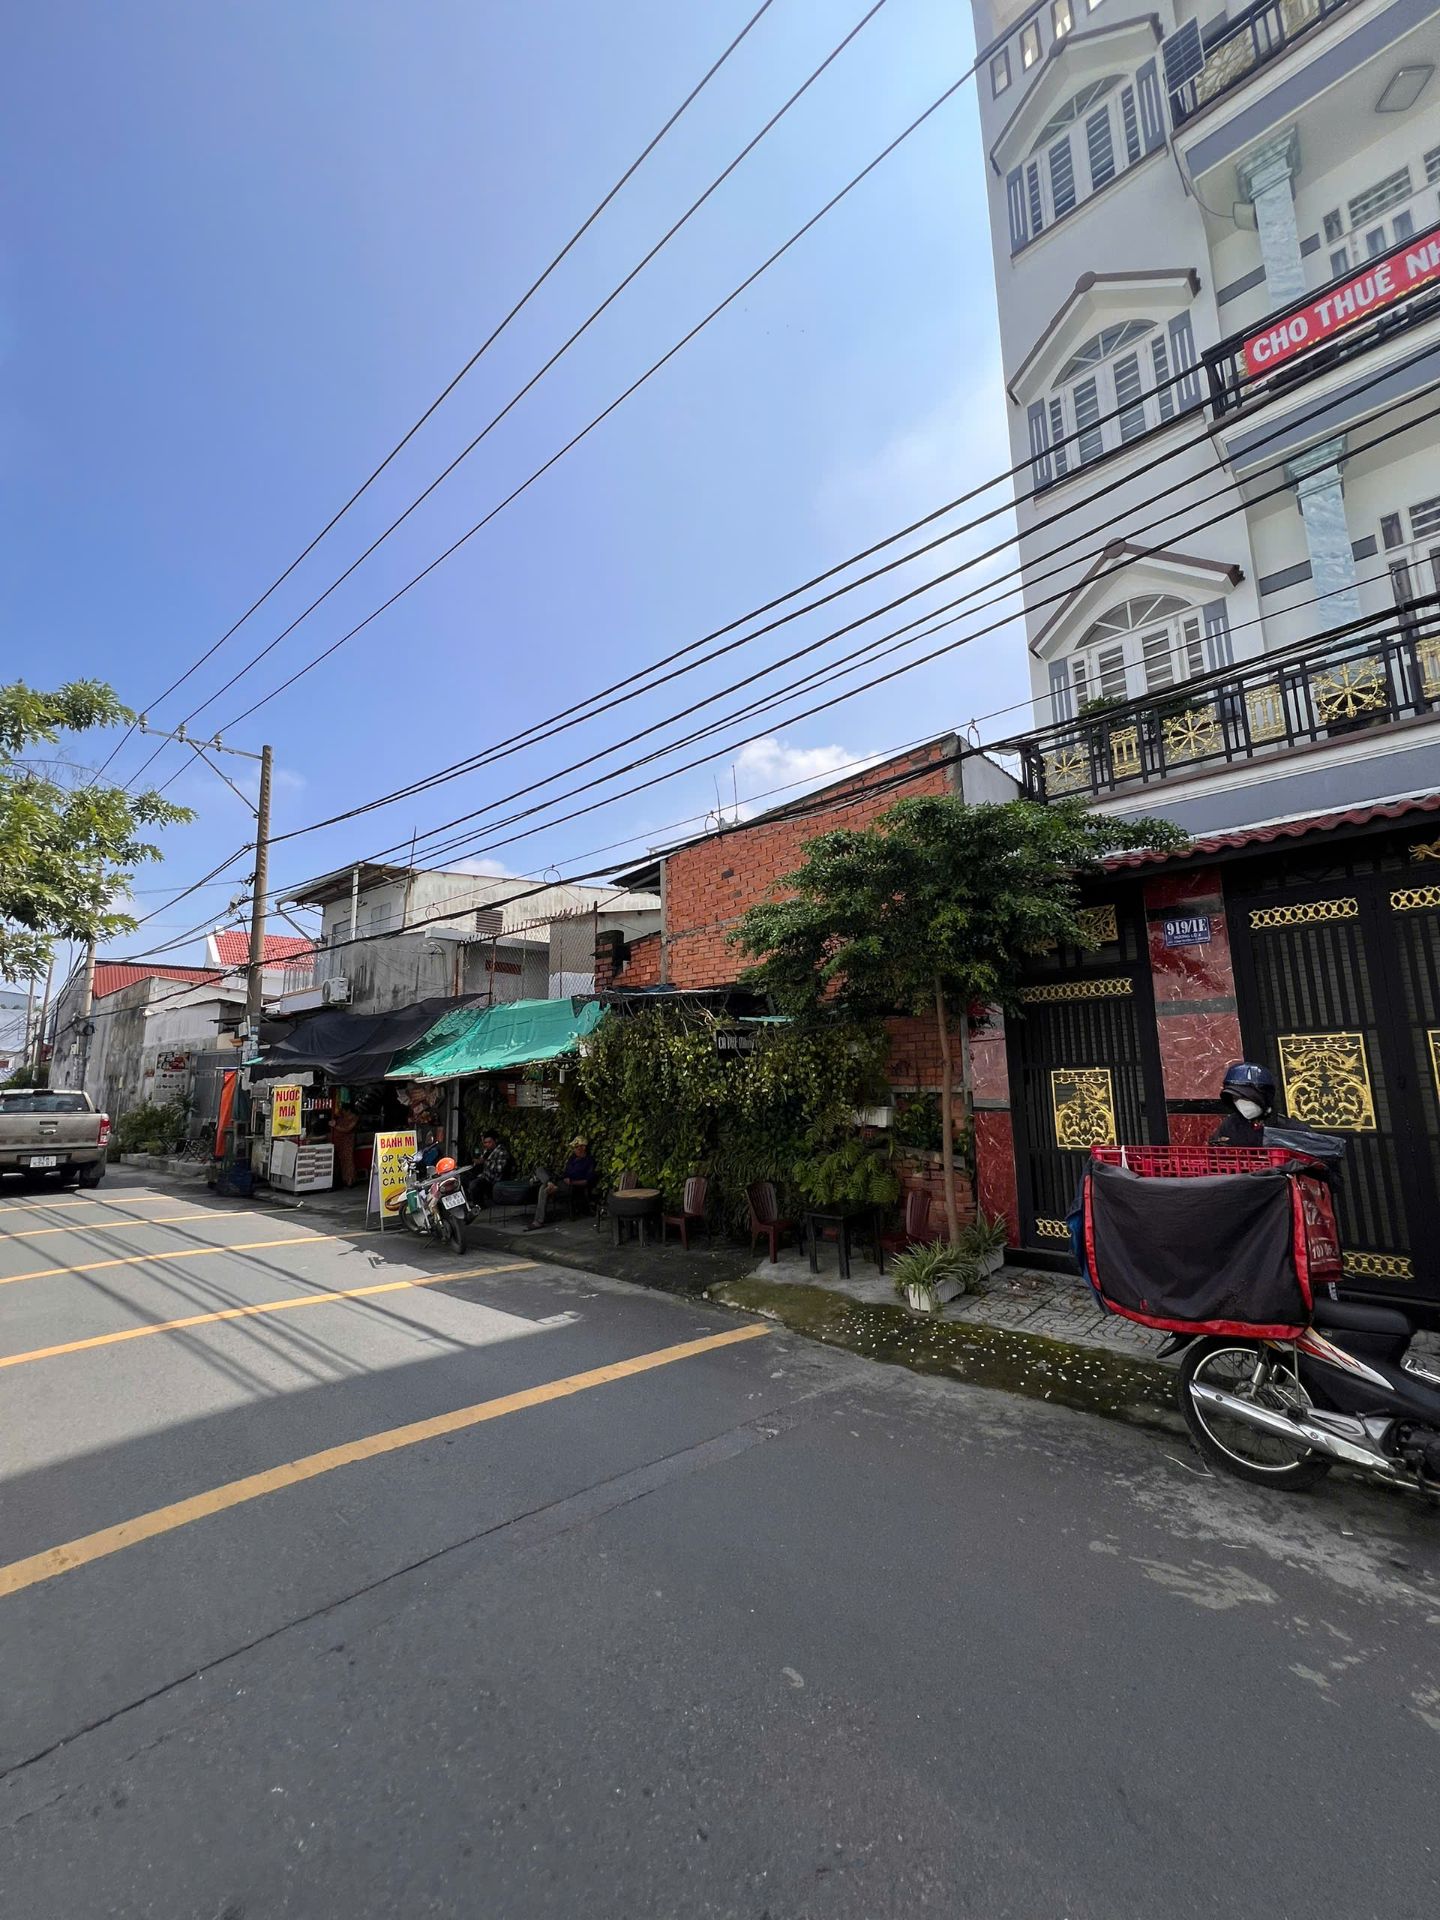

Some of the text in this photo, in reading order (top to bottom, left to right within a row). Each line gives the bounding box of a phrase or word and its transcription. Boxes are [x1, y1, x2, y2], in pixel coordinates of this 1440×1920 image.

[1252, 316, 1308, 362] CHO
[1314, 263, 1396, 327] THUÊ
[1166, 919, 1207, 935] 919/1E
[276, 1088, 300, 1102] NƯỚC
